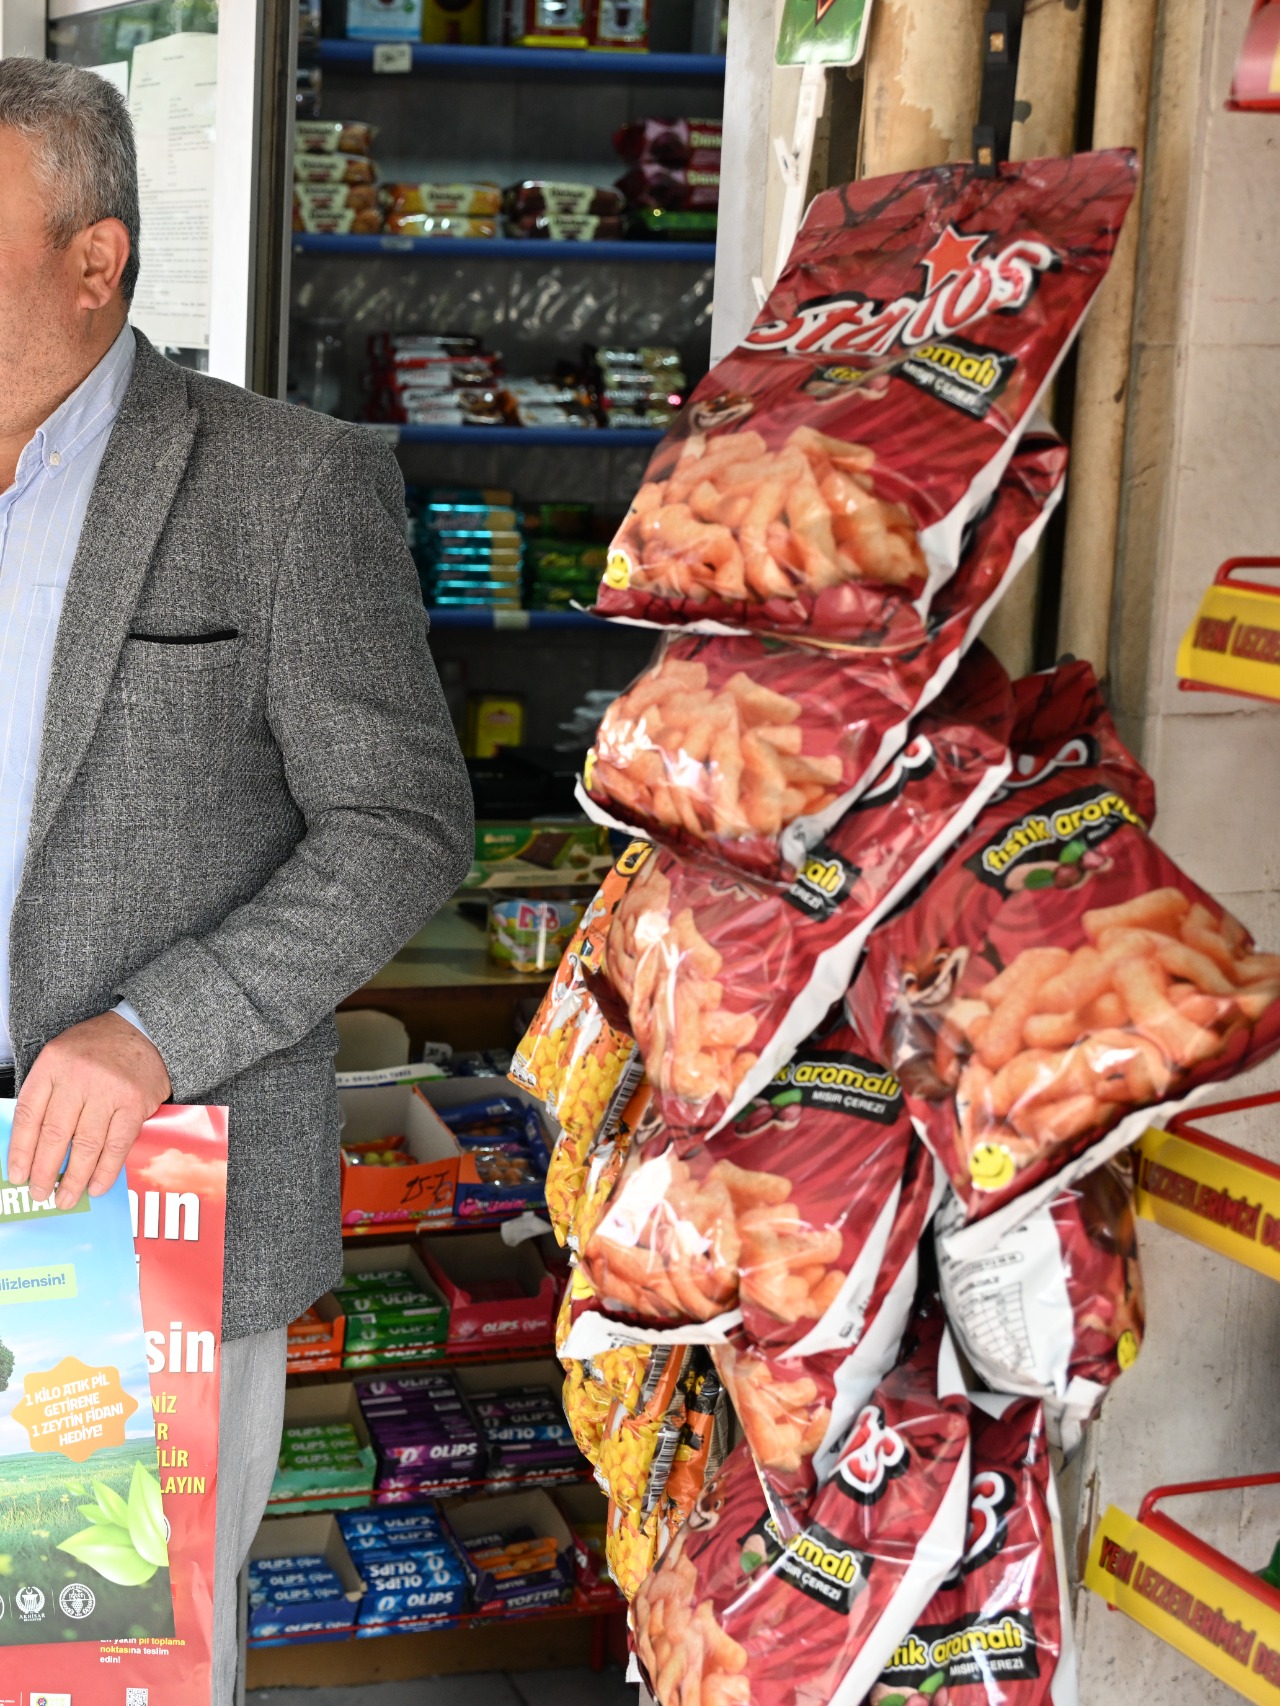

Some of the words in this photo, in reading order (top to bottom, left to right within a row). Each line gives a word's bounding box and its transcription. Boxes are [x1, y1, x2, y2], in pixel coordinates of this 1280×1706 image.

[983, 817, 1053, 875] fıstık
[793, 1062, 901, 1100] aromalı
[812, 1090, 842, 1104] MISIR
[843, 1095, 887, 1114] ÇEREZİ
[25, 1394, 34, 1407] 1
[34, 1387, 61, 1405] KİLO
[62, 1378, 91, 1397] ATIK
[91, 1371, 110, 1390] PİL
[44, 1392, 101, 1418] GETİRENE
[31, 1425, 41, 1438] 1
[41, 1411, 84, 1436] ZEYTİN
[85, 1402, 125, 1424] FİDANI
[58, 1423, 104, 1447] HEDİYE!
[100, 1645, 141, 1655] noktasına
[143, 1647, 169, 1656] teslim
[151, 1638, 186, 1647] toplama
[932, 1618, 1024, 1666] aromalı
[100, 1655, 121, 1664] edin!
